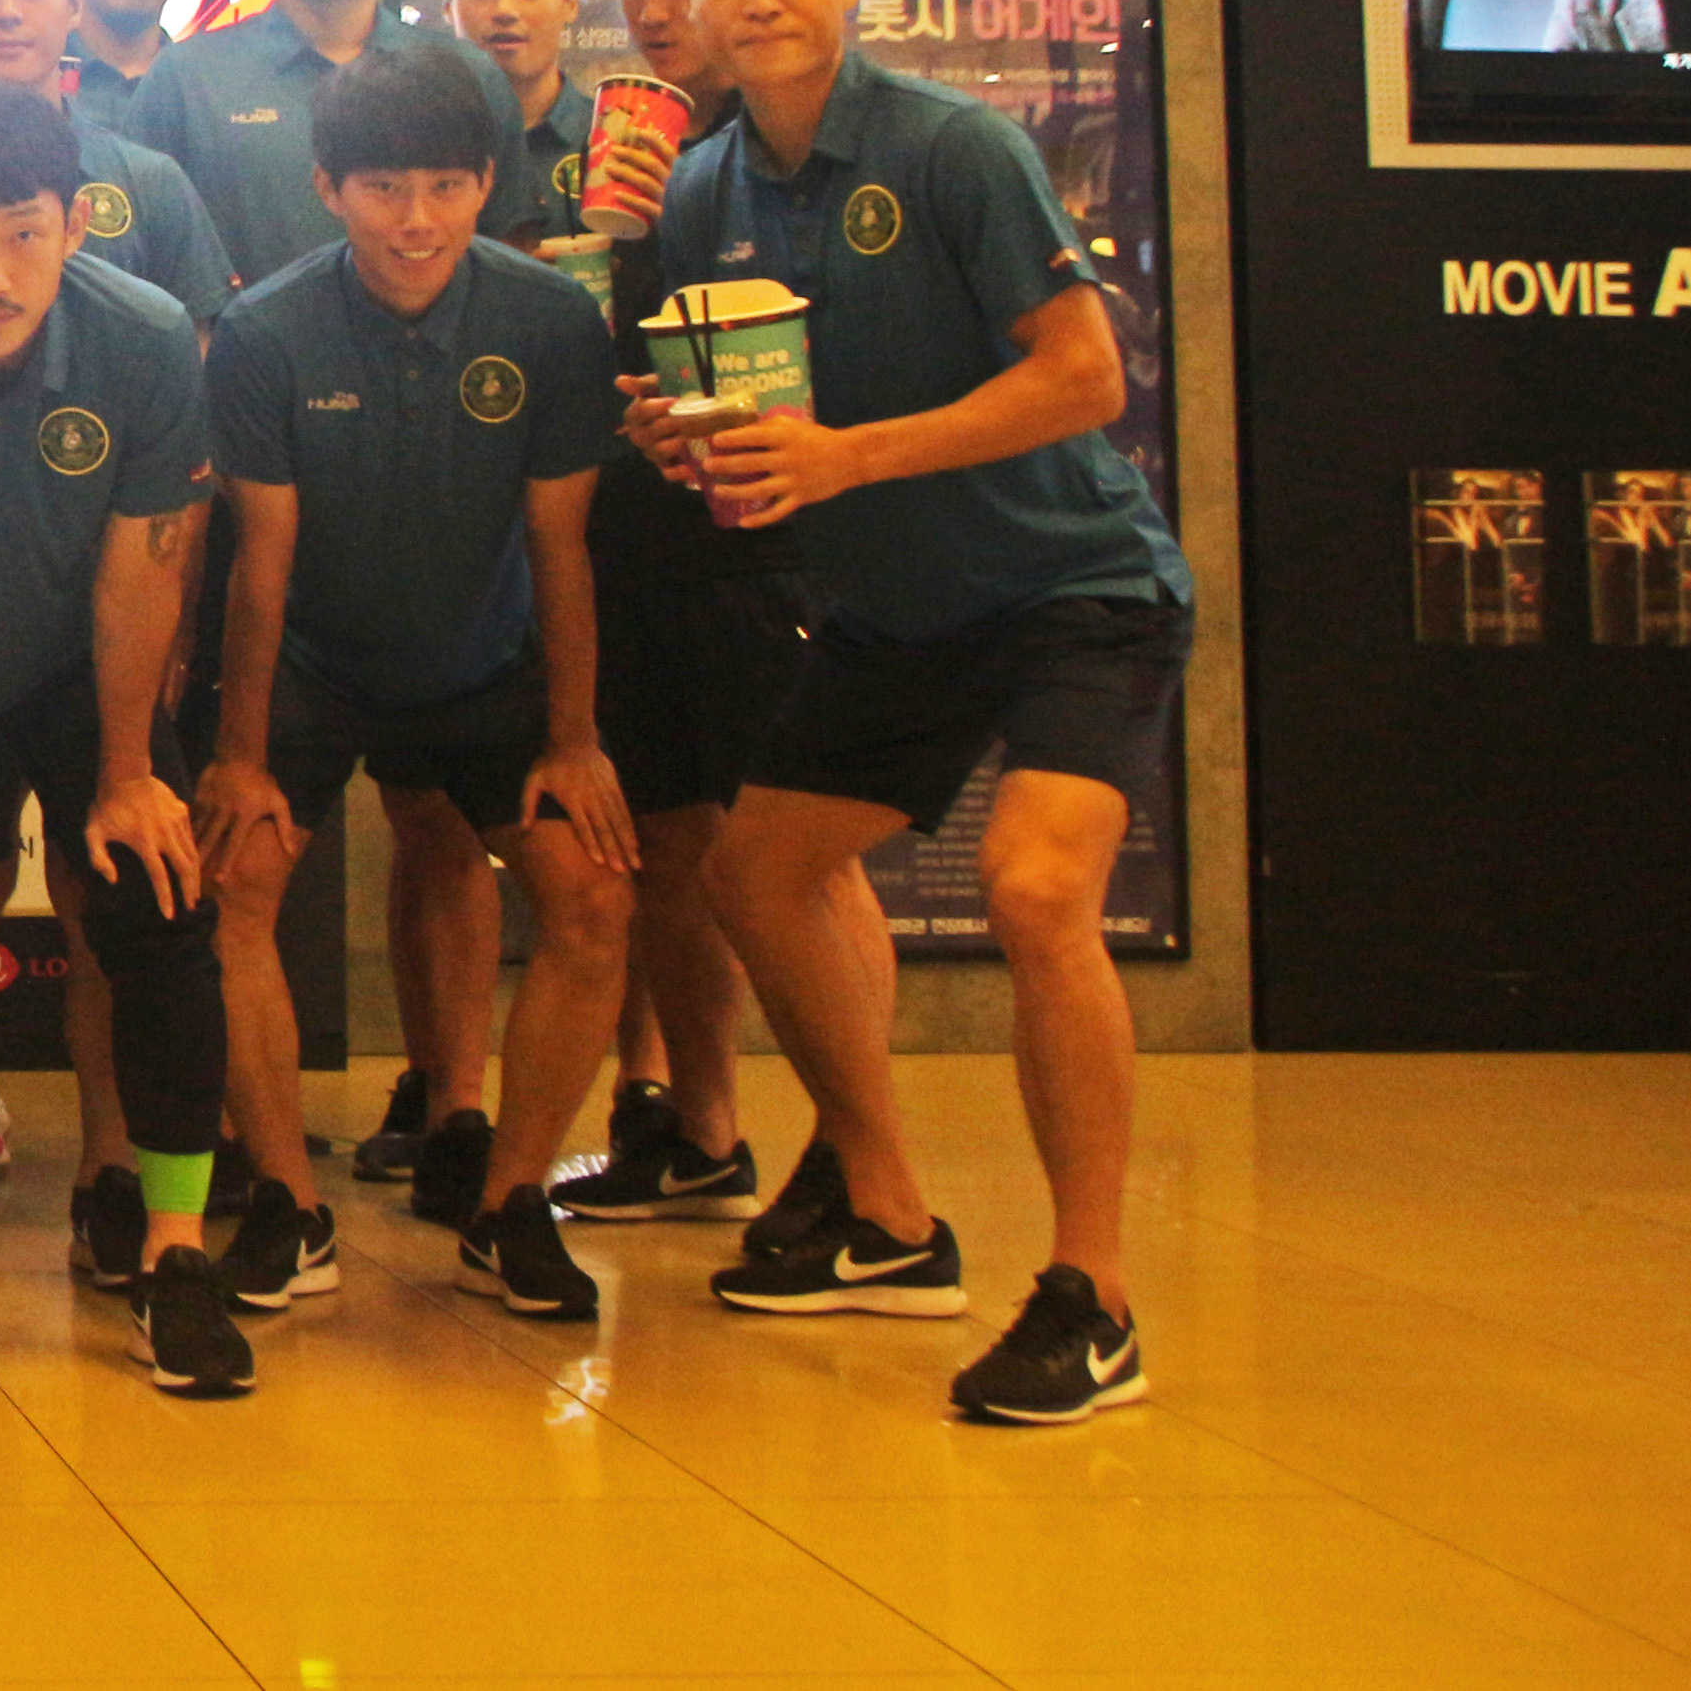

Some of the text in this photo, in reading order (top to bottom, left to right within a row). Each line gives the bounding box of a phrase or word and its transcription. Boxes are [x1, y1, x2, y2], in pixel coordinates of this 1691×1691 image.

[1443, 260, 1634, 317] MOVIE
[713, 349, 787, 371] We are
